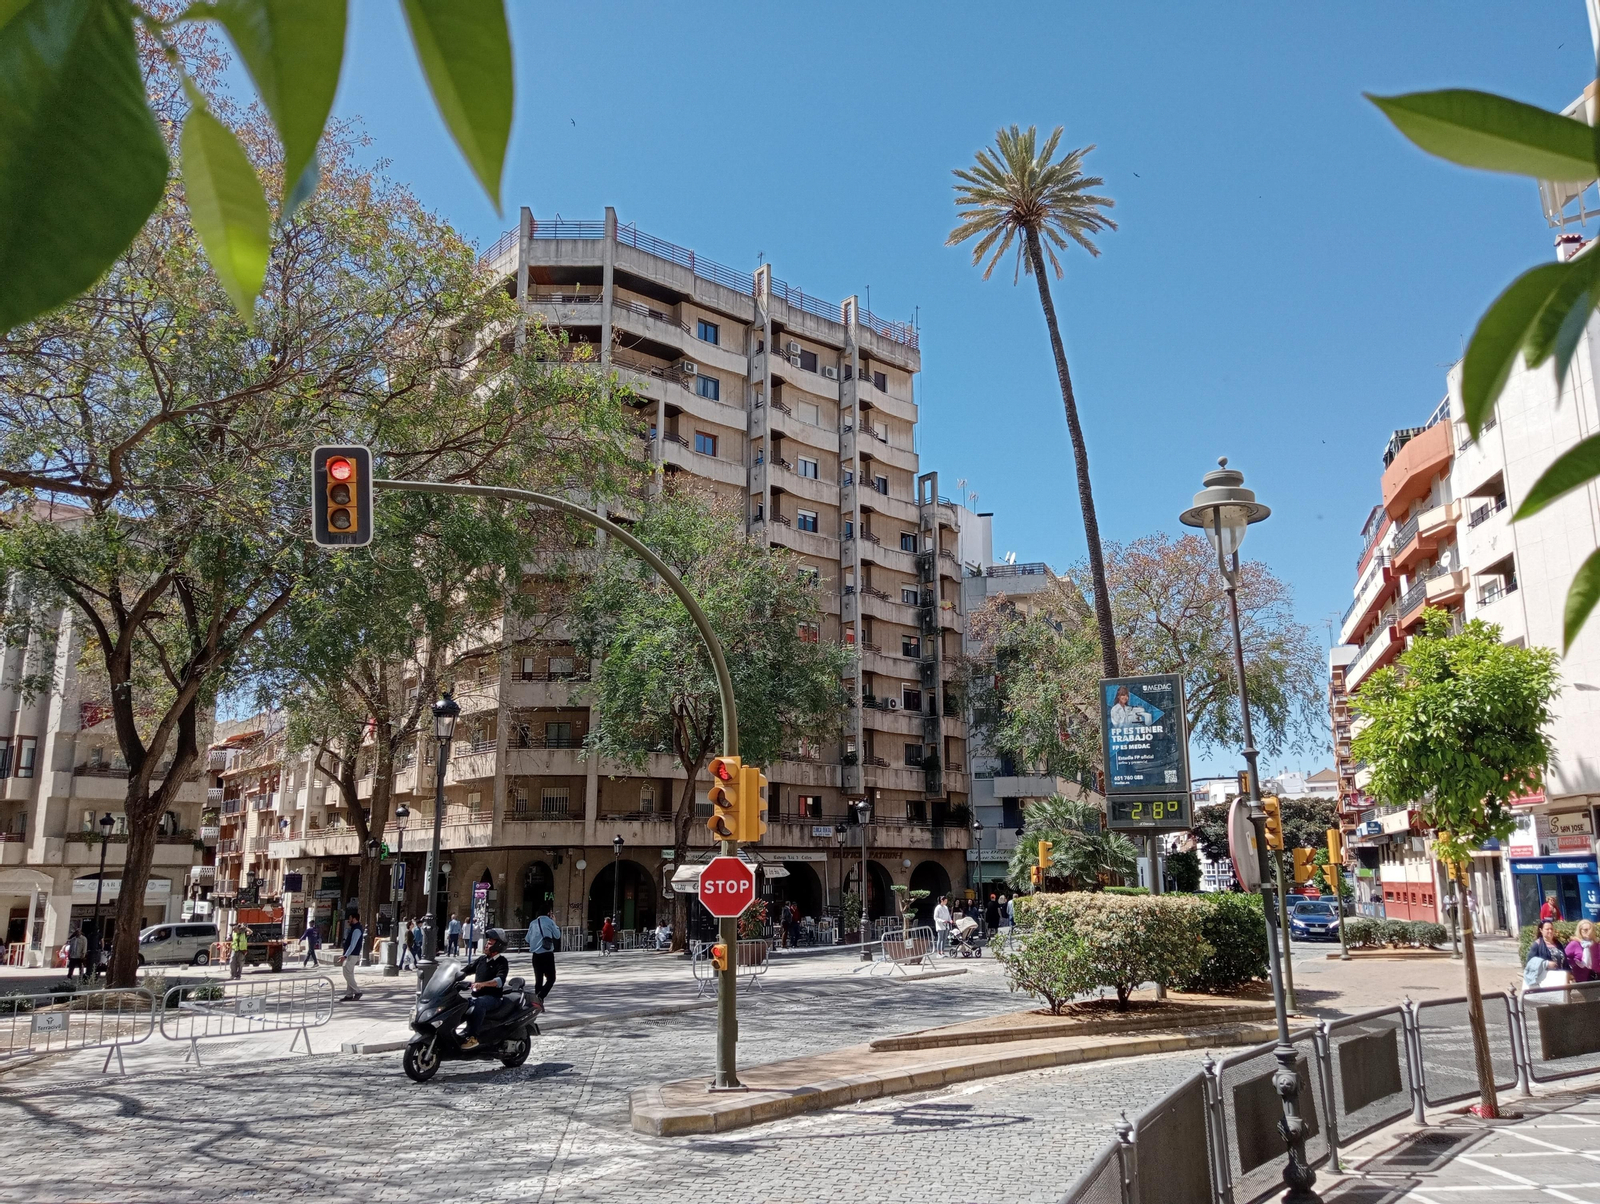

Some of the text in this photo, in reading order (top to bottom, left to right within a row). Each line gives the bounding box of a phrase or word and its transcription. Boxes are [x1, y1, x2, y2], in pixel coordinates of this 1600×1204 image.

[1147, 683, 1171, 691] MEDAC
[1123, 727, 1133, 735] ES
[1135, 725, 1163, 734] TENER
[1111, 733, 1153, 742] TRABAJO
[1560, 825, 1570, 833] SAN
[704, 880, 750, 894] STOP
